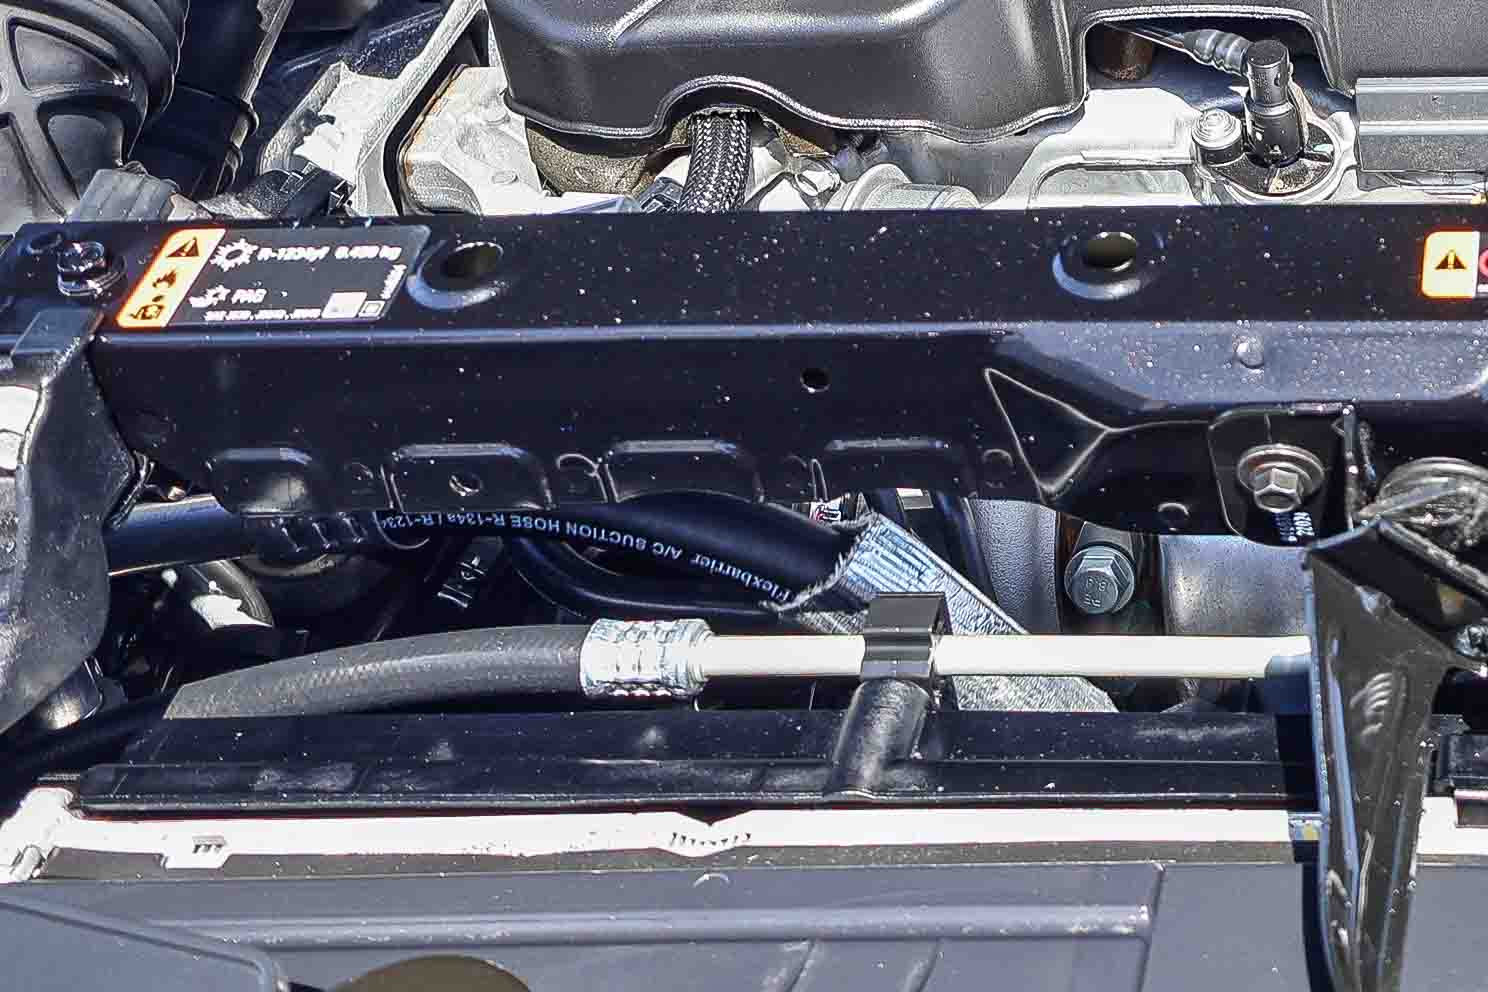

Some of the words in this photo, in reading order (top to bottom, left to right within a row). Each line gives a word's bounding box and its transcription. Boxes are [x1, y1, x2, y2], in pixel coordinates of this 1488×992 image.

[511, 514, 560, 533] HOSE
[566, 521, 647, 551] SUCTION
[651, 542, 684, 560] A/C
